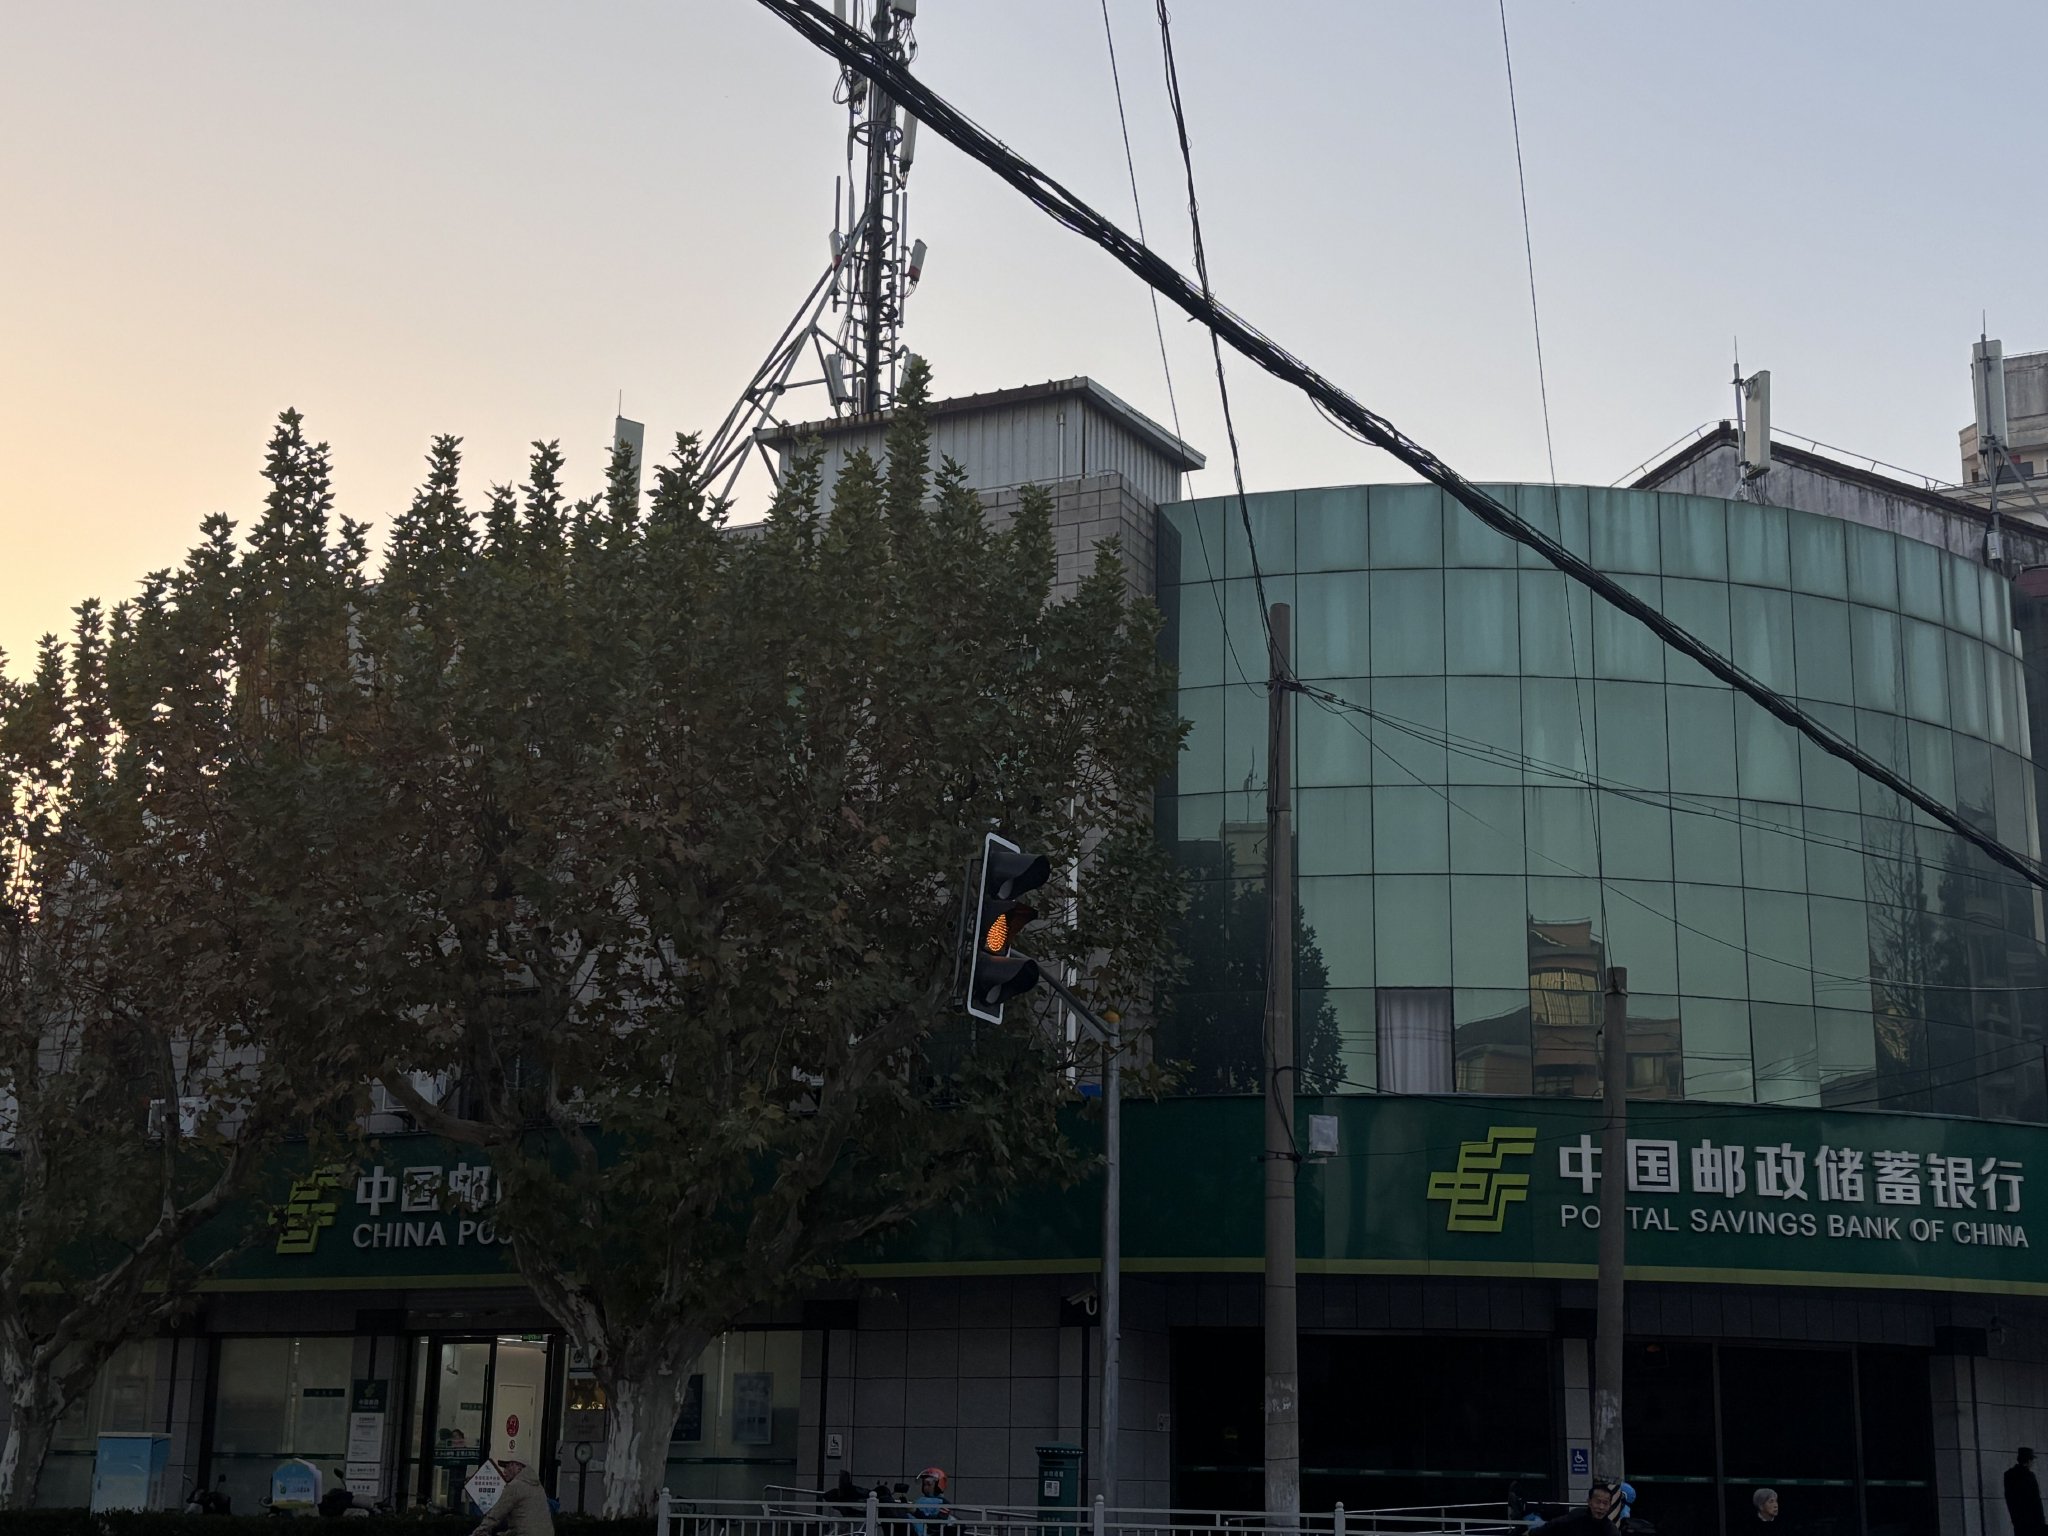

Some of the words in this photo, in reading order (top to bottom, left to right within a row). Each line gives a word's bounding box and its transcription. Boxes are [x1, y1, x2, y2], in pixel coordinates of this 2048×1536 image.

[356, 1162, 501, 1216] 中国邮
[1559, 1134, 2025, 1213] 中国邮政储蓄银行
[353, 1220, 447, 1248] CHINA
[1560, 1204, 1680, 1232] POTAL
[1690, 1208, 1817, 1237] SAVINGS
[1827, 1214, 1902, 1240] BANK
[1909, 1218, 1945, 1242] OF
[1952, 1221, 2029, 1248] CHINA
